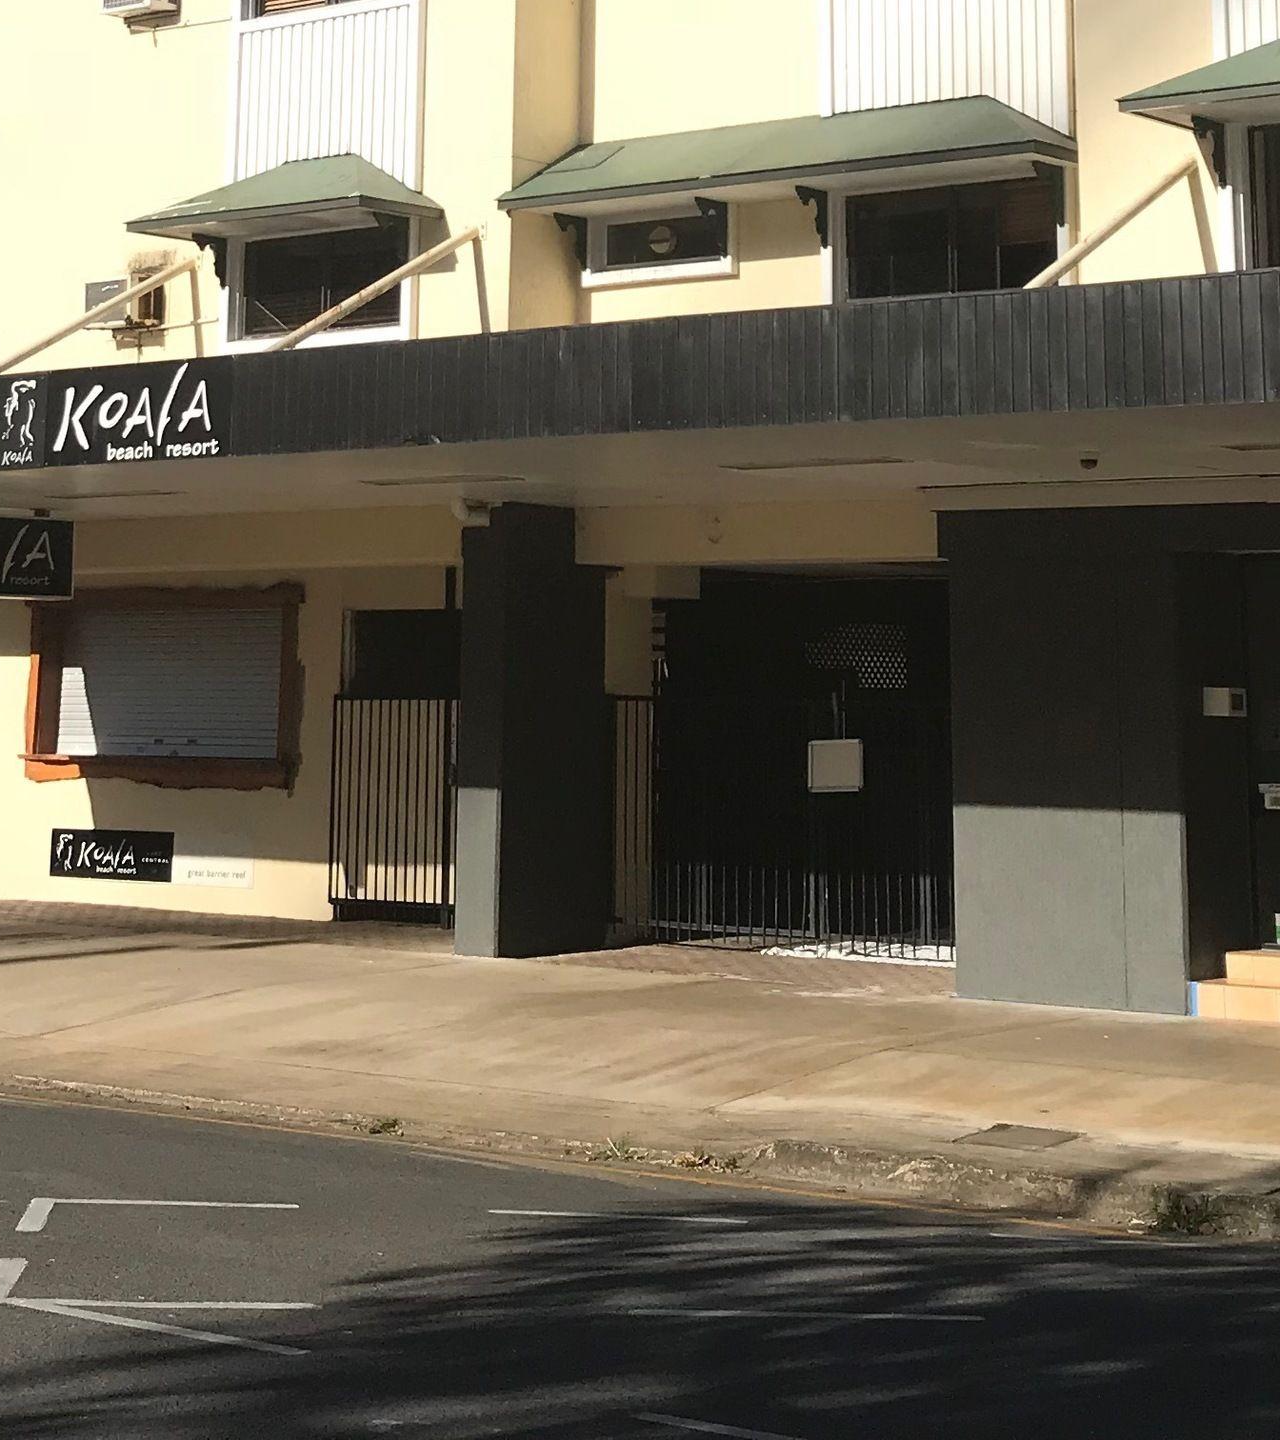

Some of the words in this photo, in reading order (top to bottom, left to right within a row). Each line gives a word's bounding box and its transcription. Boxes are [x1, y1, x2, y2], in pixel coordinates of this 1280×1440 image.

[106, 441, 153, 461] beach
[166, 438, 220, 457] resort
[10, 576, 50, 586] resort
